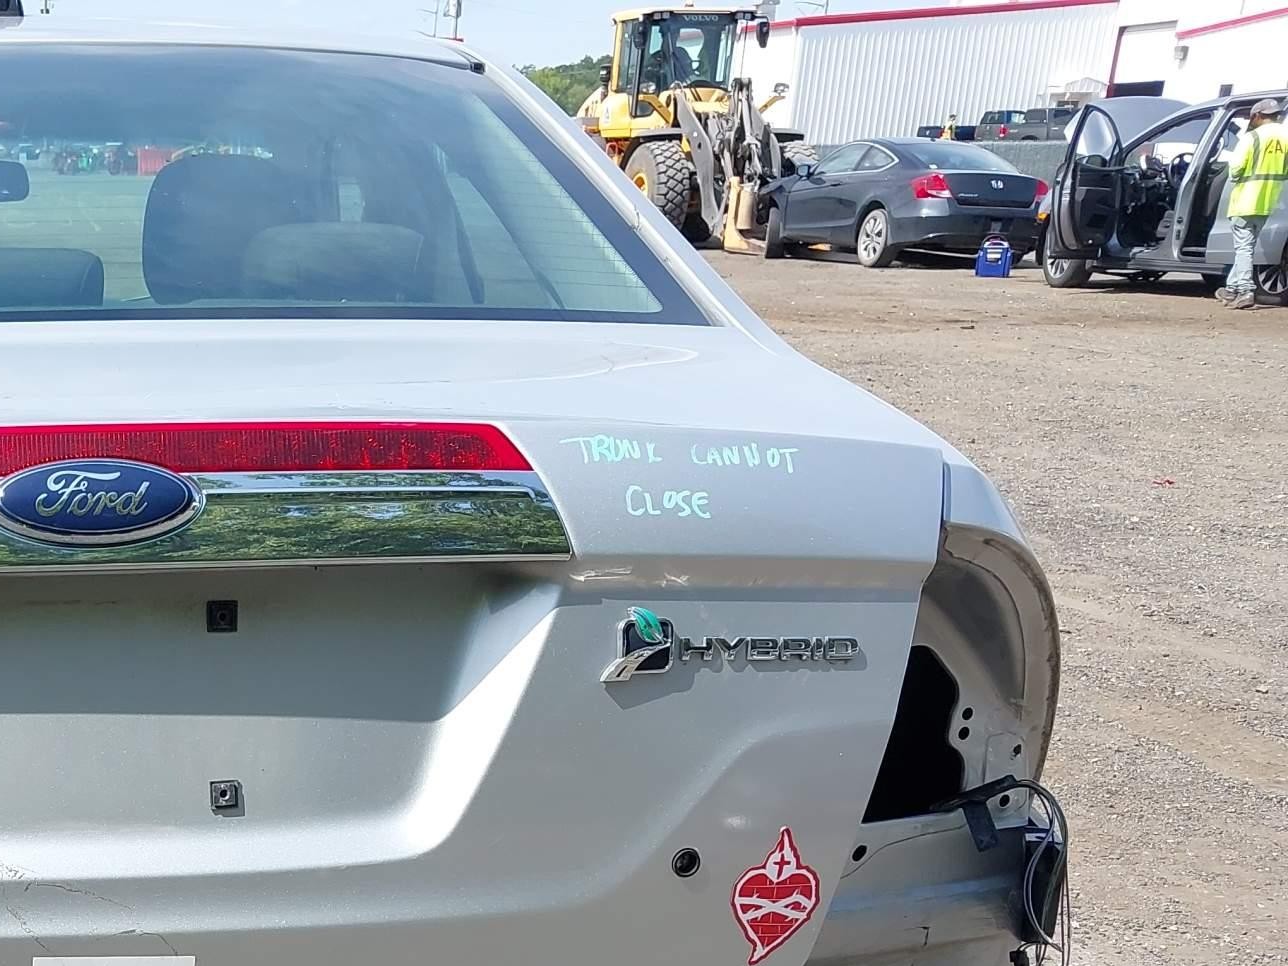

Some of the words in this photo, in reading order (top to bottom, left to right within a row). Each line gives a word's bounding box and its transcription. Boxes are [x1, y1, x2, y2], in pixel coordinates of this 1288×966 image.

[559, 434, 663, 464] TRUNK
[691, 443, 799, 473] CANNOT
[35, 470, 150, 517] Ford
[626, 485, 711, 518] CLOSE
[680, 637, 859, 661] HYBRID
